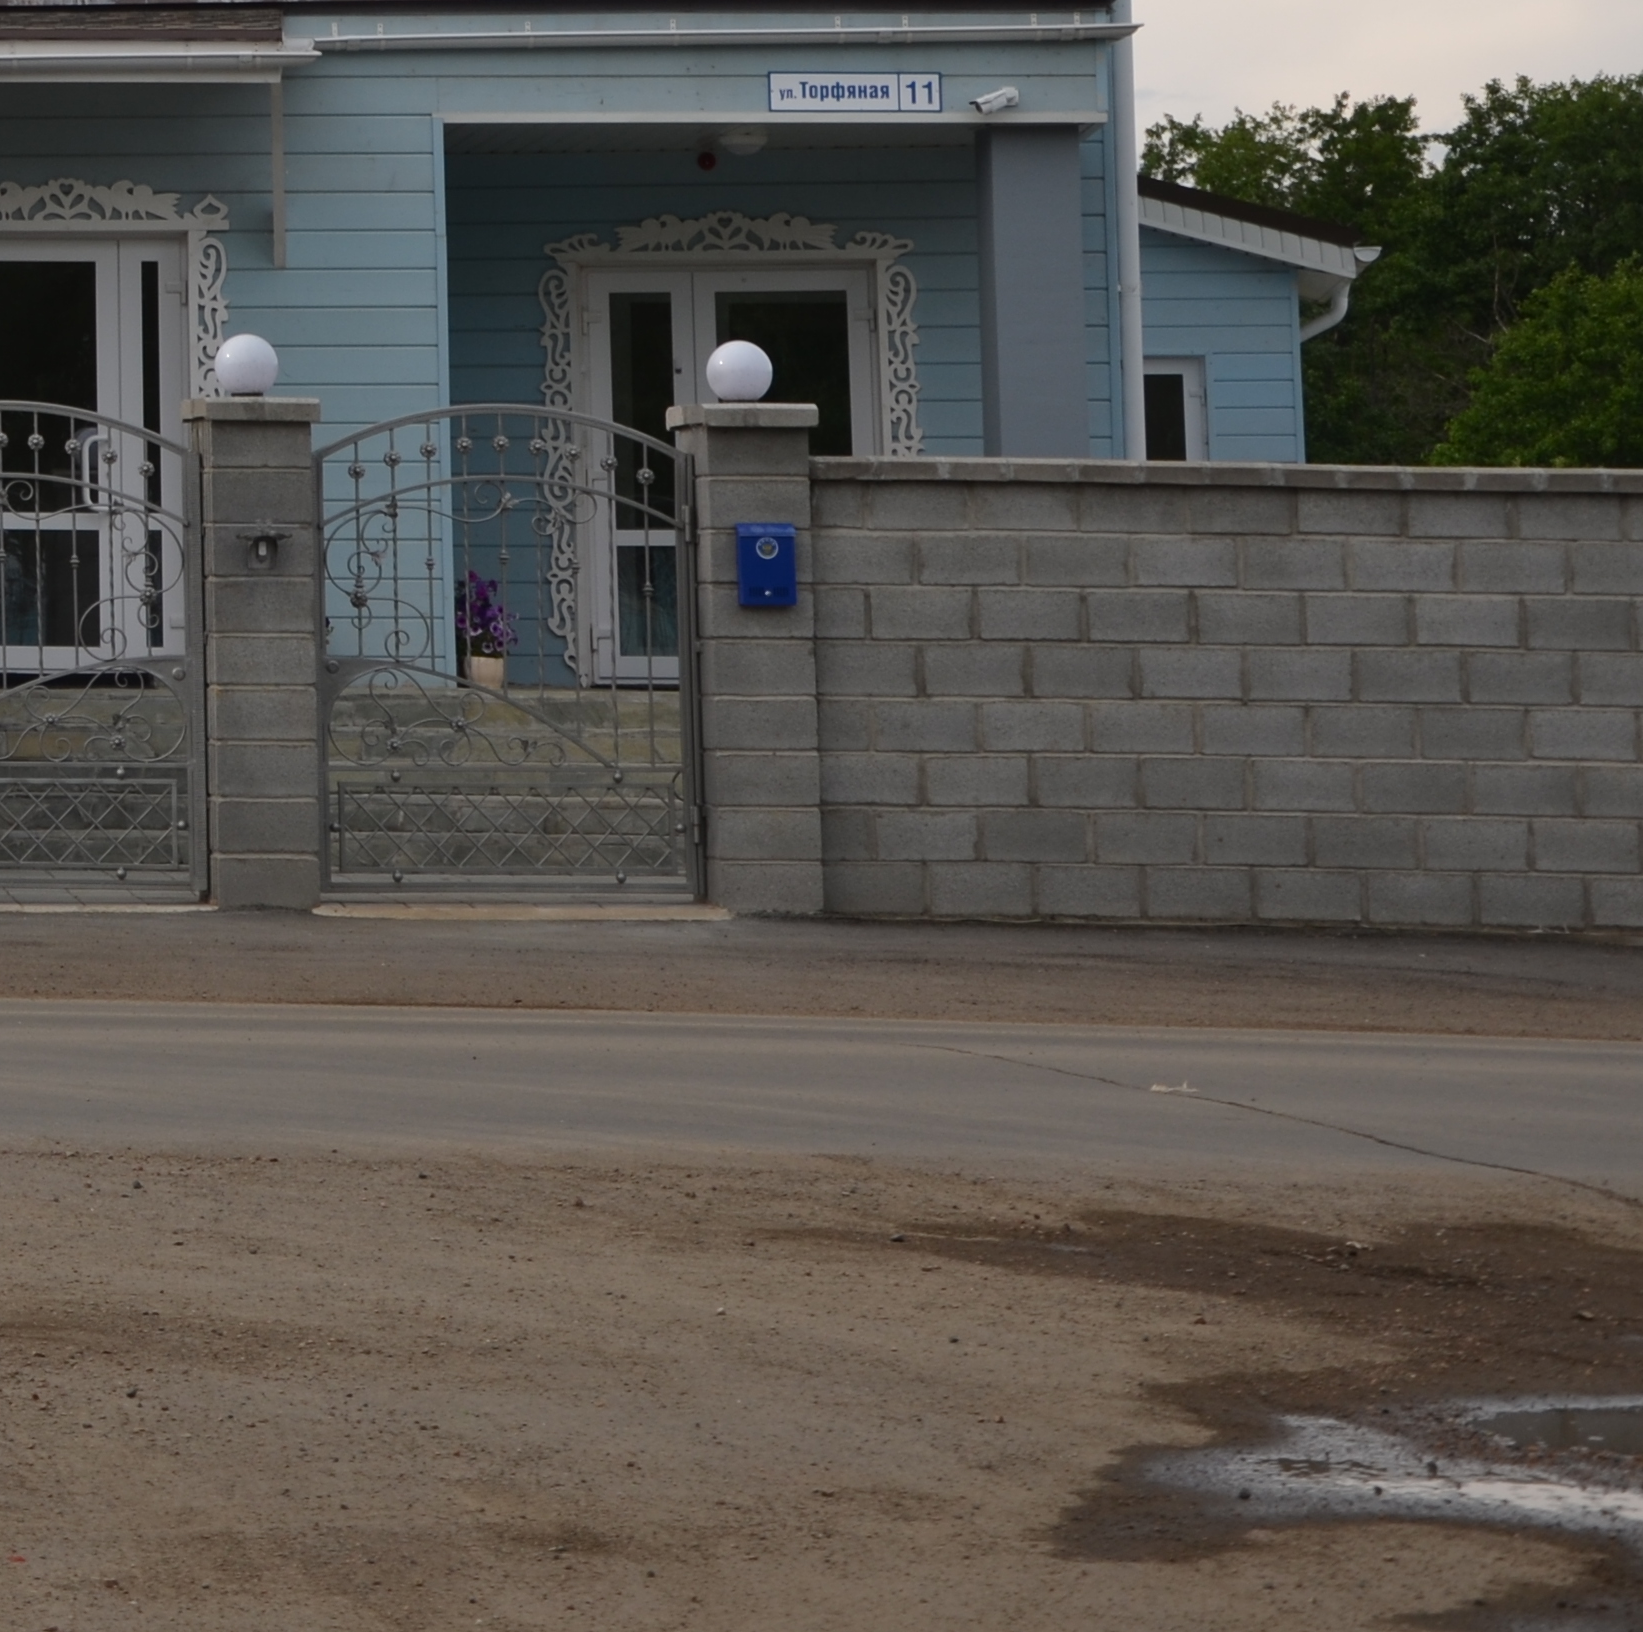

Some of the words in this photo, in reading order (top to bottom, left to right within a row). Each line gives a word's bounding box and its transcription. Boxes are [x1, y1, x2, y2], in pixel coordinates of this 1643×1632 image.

[779, 87, 797, 100] ул.
[799, 81, 890, 101] Торфяная
[905, 81, 933, 104] 11
